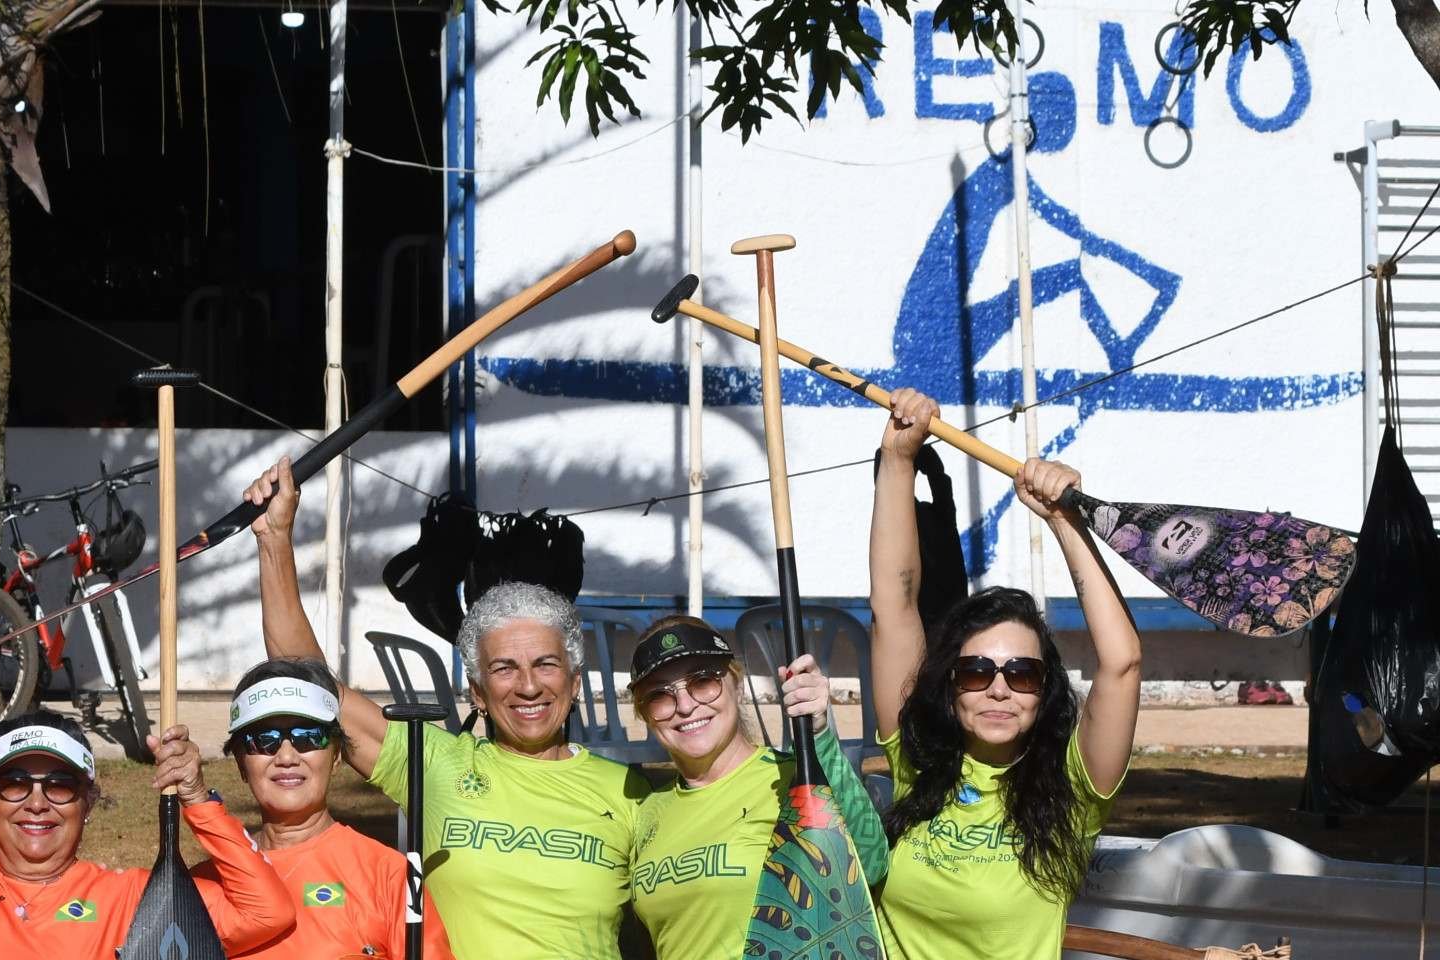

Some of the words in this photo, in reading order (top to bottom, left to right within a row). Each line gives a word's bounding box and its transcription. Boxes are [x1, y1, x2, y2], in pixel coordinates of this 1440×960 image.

[248, 686, 308, 706] BRASIL
[11, 729, 44, 742] REMO
[440, 817, 616, 871] BRASIL
[632, 843, 747, 902] RASIL
